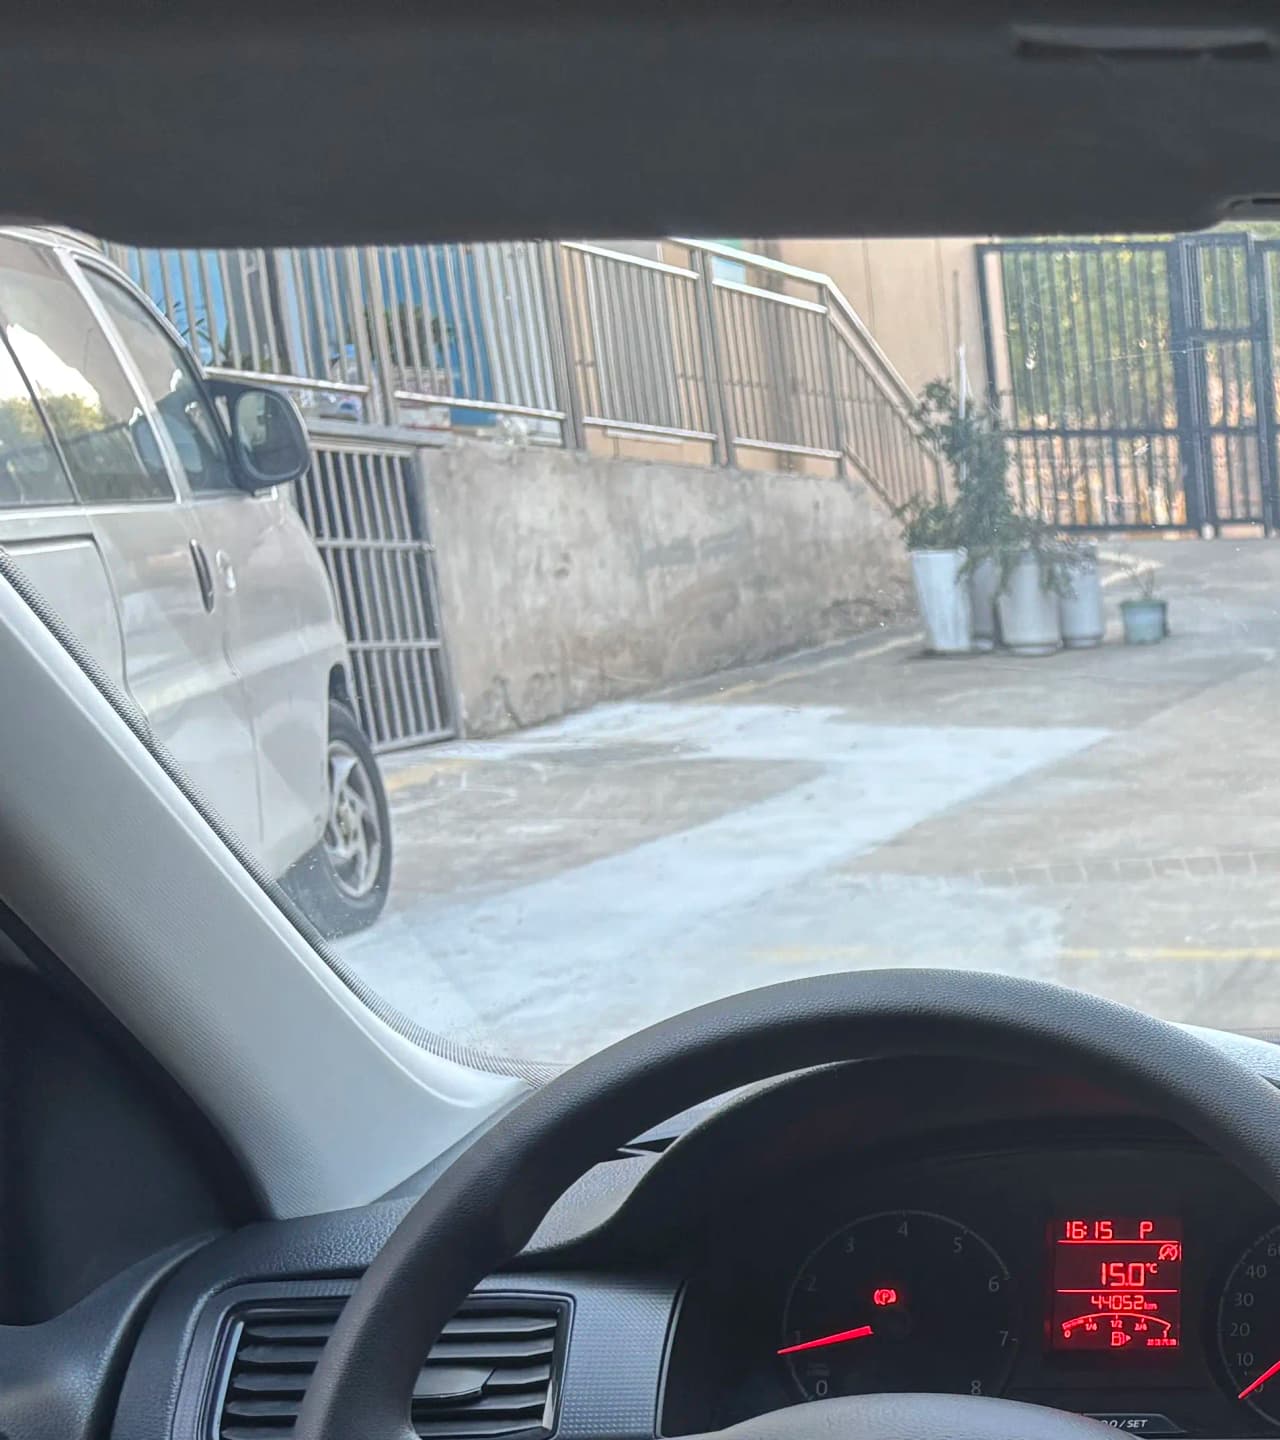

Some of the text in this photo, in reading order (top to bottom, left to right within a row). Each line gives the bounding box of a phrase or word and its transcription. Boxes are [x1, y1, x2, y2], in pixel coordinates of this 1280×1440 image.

[896, 1220, 910, 1238] 4
[1065, 1220, 1154, 1240] 16:15 P
[953, 1236, 963, 1253] 5
[1245, 1263, 1268, 1279] 40
[988, 1275, 1000, 1292] 6
[1235, 1292, 1255, 1307] 30
[1109, 1318, 1124, 1329] 1/2
[1229, 1322, 1251, 1337] 20
[999, 1330, 1009, 1347] 7
[1063, 1328, 1072, 1339] 0
[1237, 1351, 1254, 1367] 10
[815, 1379, 828, 1397] 0
[969, 1379, 982, 1396] 8
